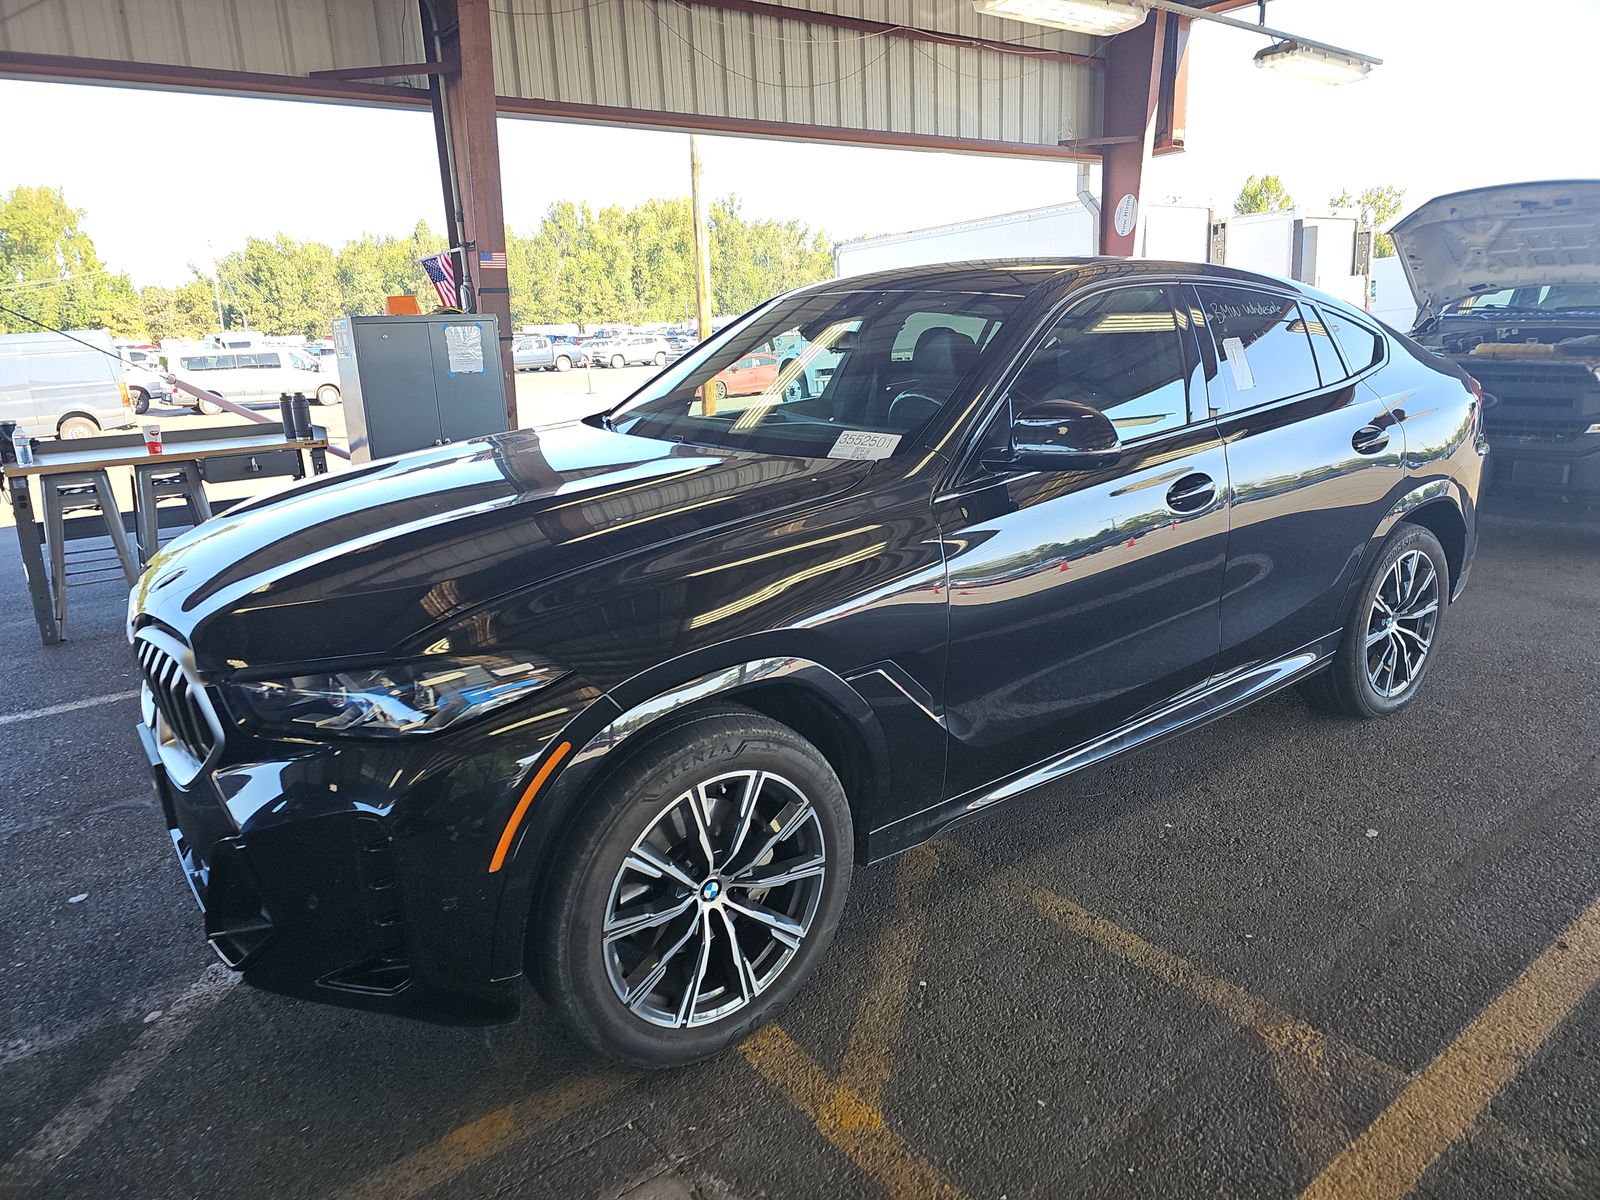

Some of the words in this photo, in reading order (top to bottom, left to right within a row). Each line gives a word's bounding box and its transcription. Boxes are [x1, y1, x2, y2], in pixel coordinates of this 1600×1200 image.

[1209, 302, 1241, 324] BMW
[839, 434, 893, 448] 3552501
[657, 742, 732, 790] ALENZA
